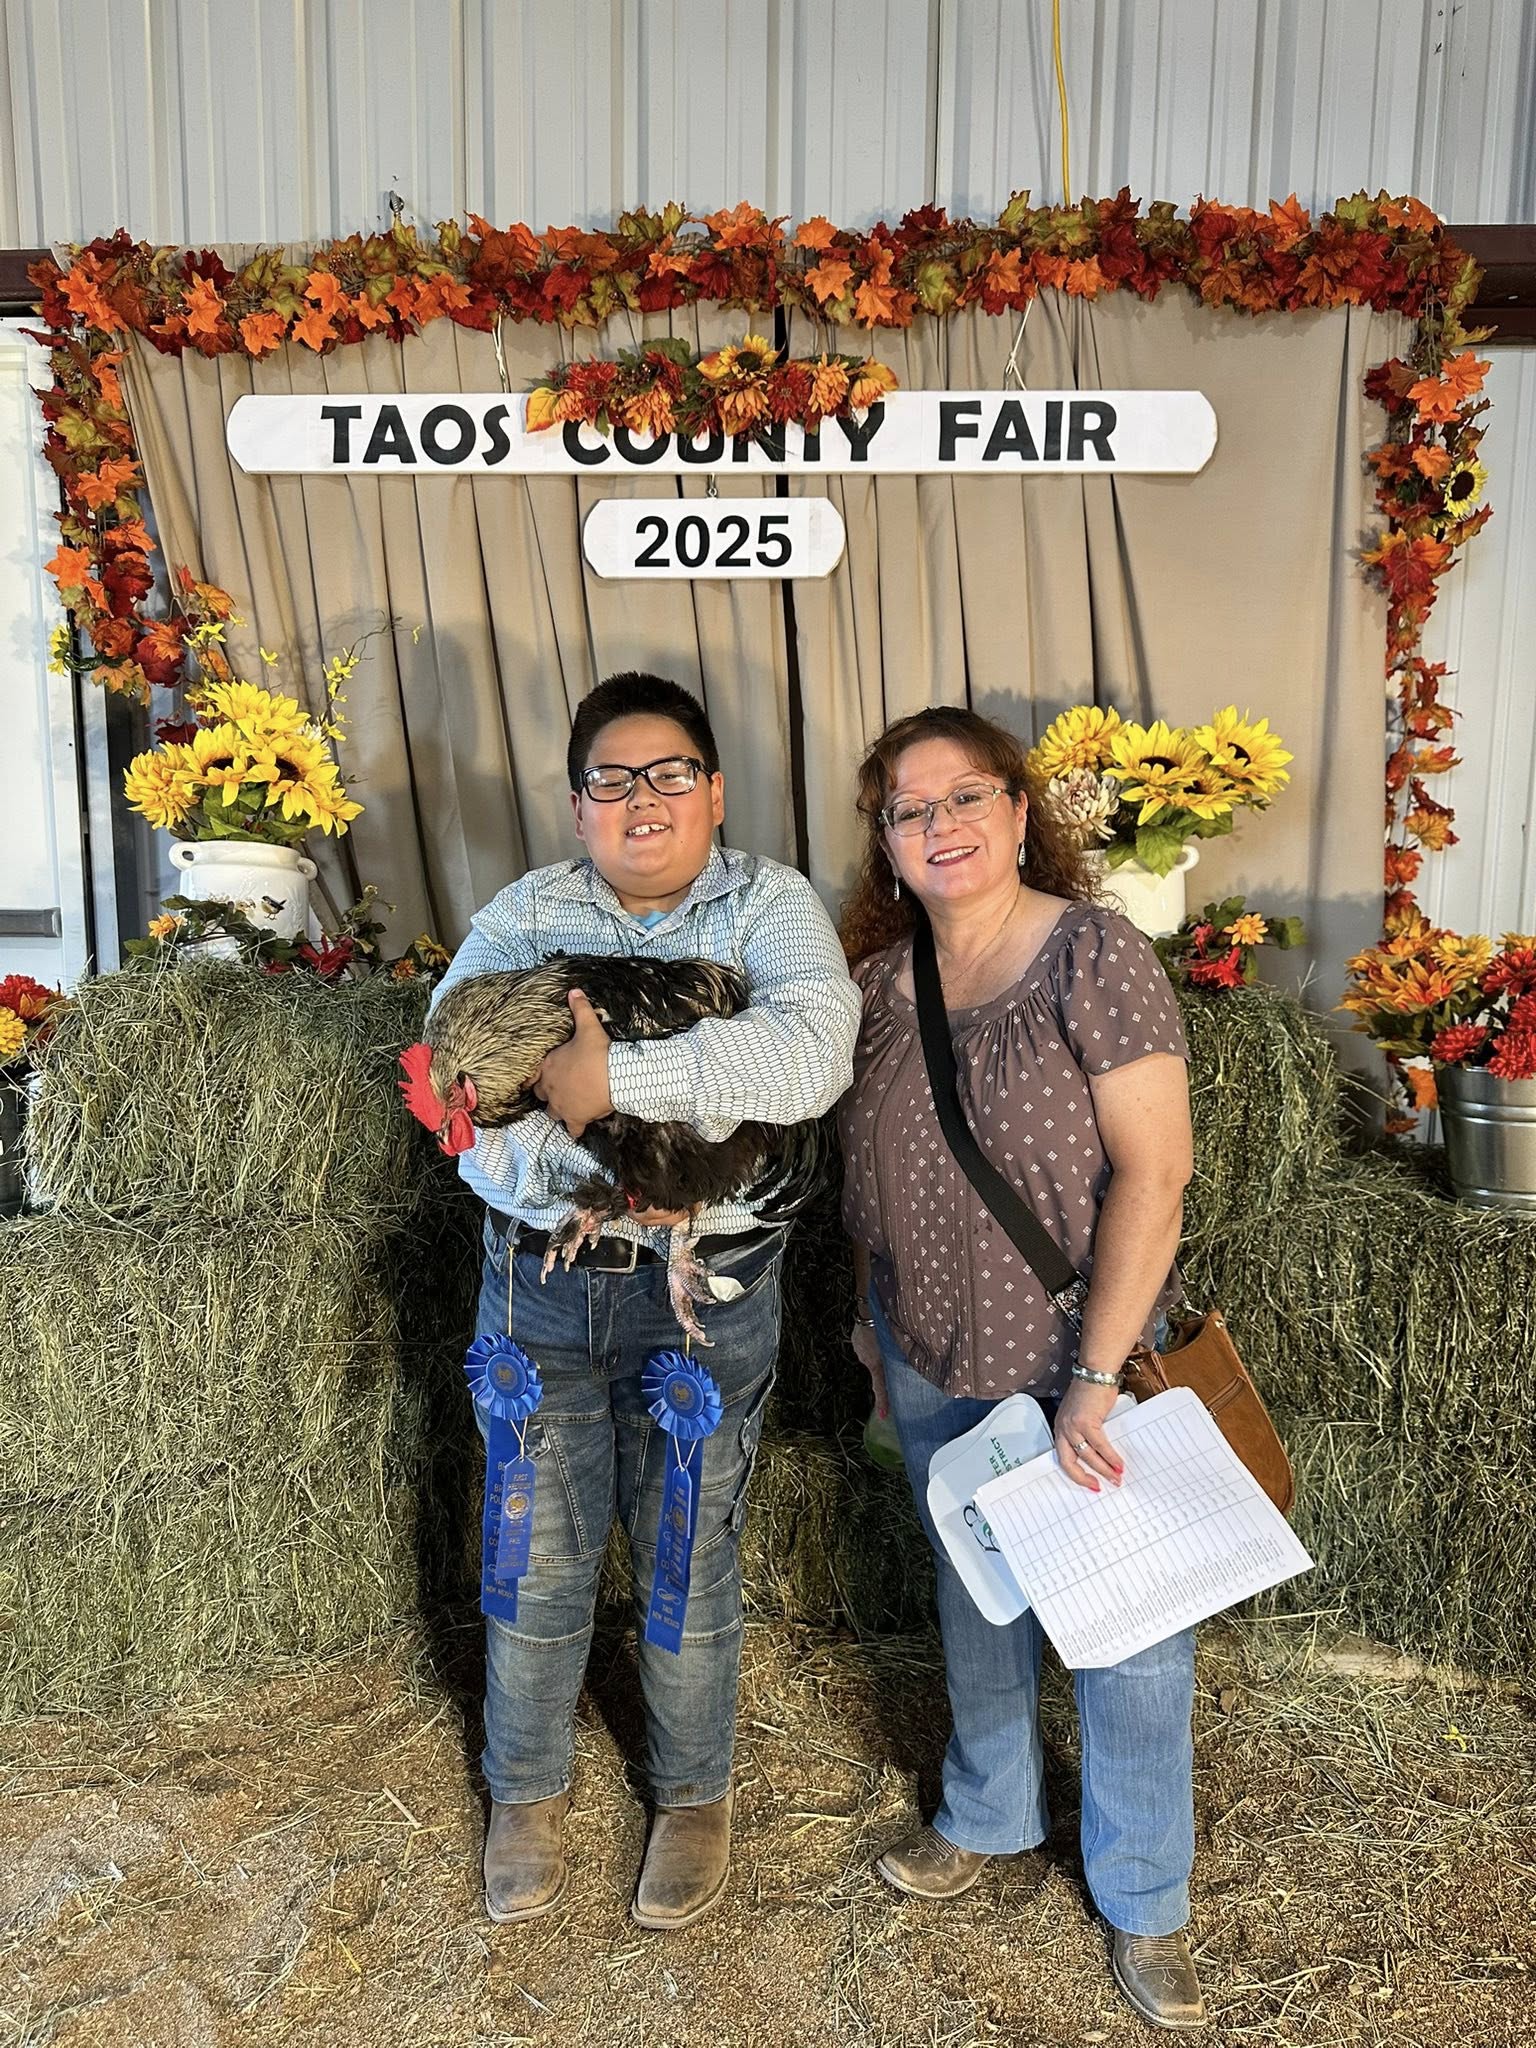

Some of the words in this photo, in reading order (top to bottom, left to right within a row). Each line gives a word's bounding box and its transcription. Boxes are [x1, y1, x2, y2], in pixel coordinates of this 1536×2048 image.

[320, 404, 511, 466] TAOS
[938, 399, 1117, 462] FAIR
[634, 515, 792, 568] 2025
[989, 1455, 1004, 1476] TER
[990, 1437, 1013, 1472] STRICT
